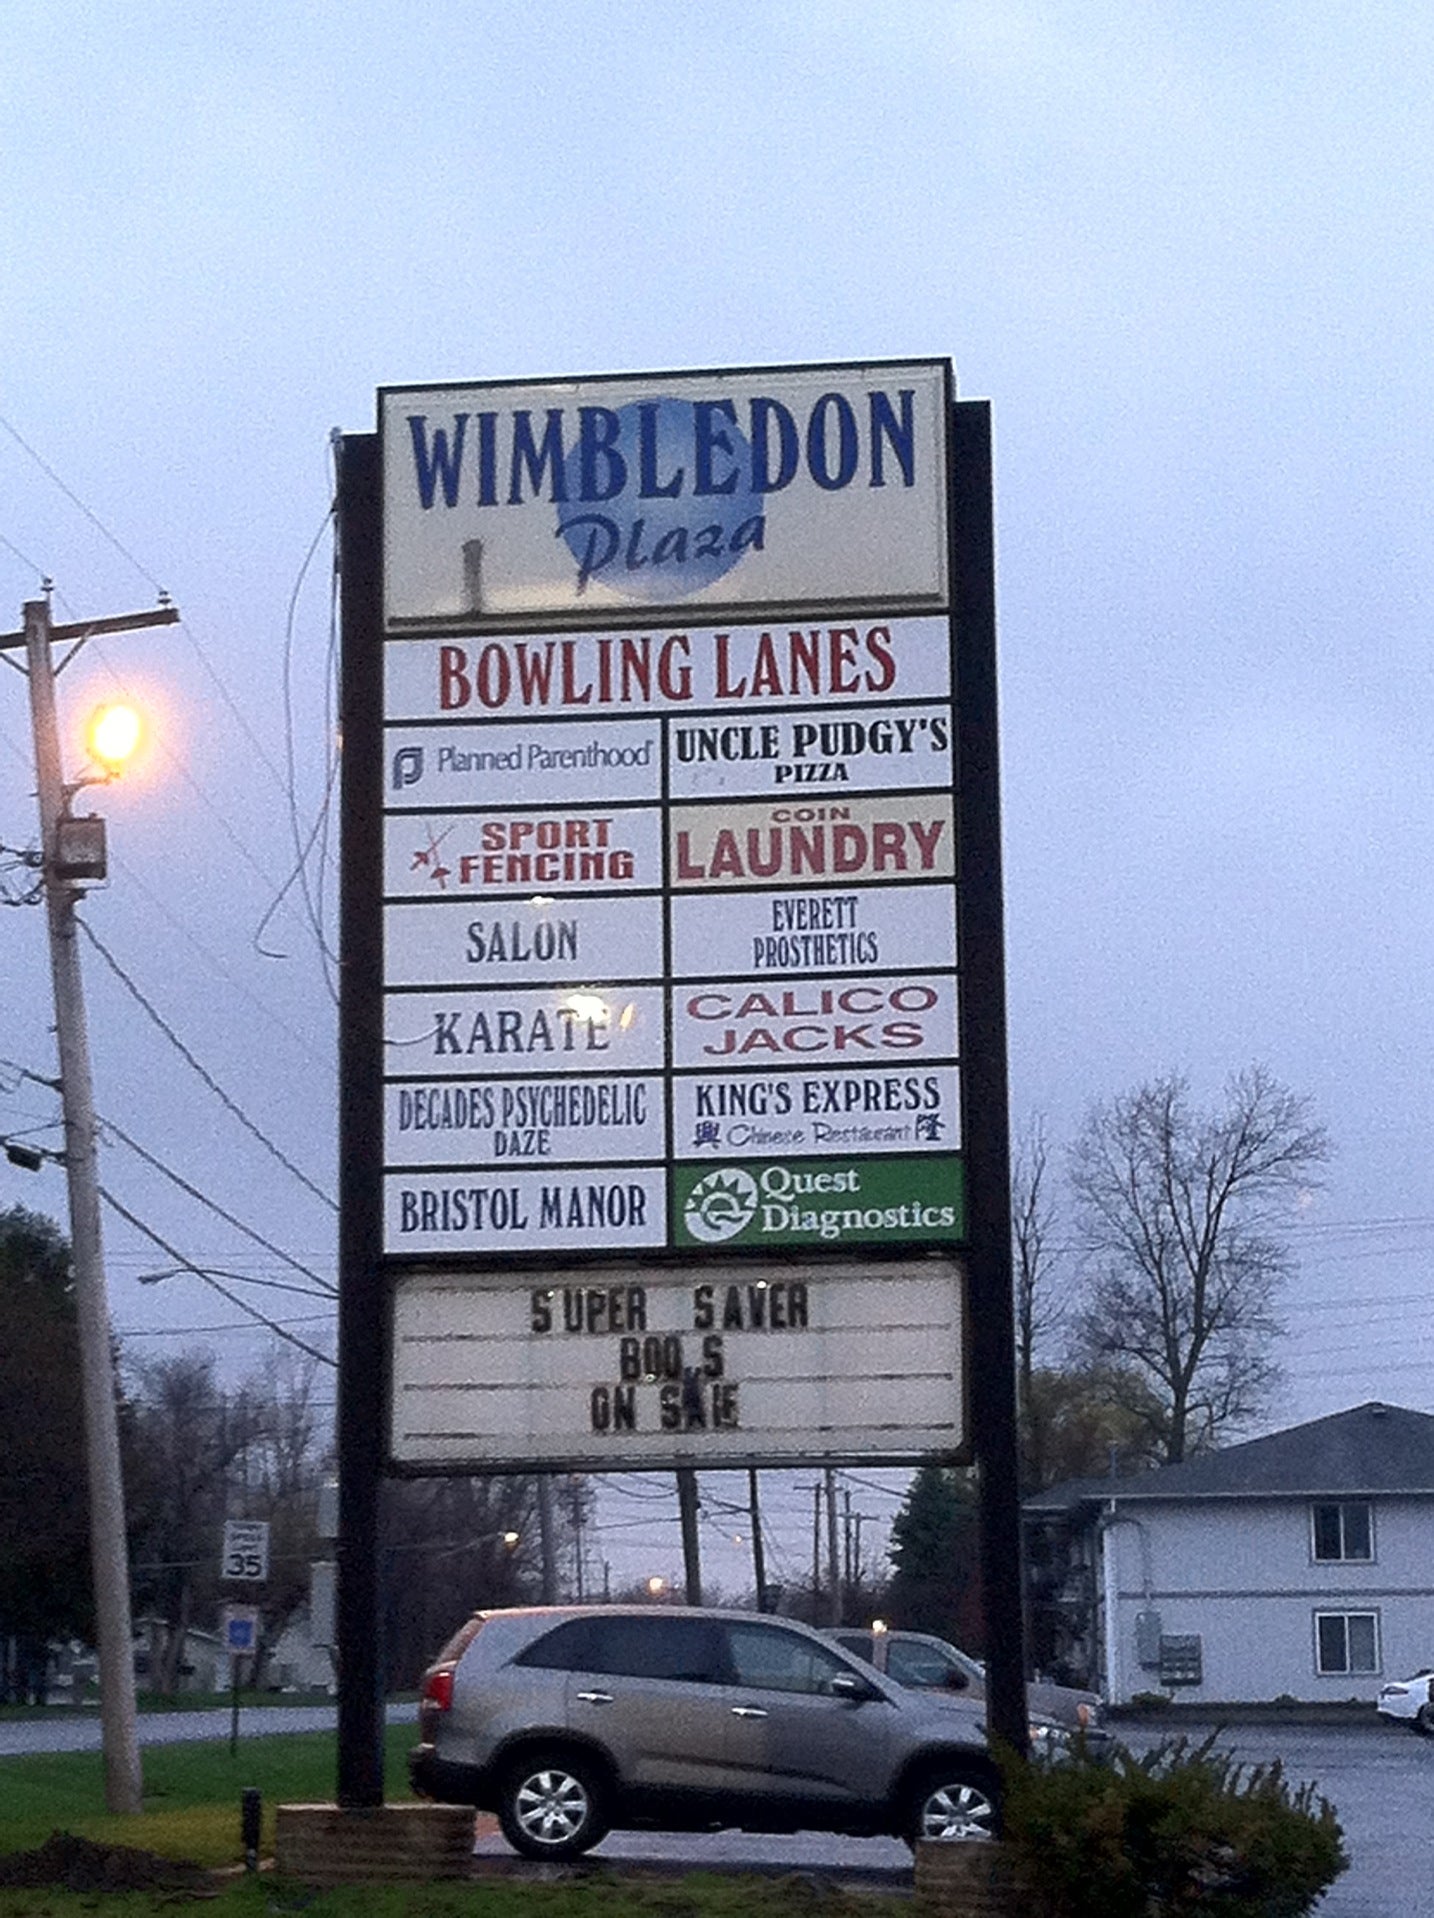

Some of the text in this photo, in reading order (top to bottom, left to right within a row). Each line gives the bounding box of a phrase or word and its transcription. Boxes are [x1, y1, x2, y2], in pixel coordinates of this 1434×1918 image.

[406, 389, 916, 510] WIMBLEDON
[555, 512, 766, 596] Plaza
[438, 625, 896, 712] BOWLING LANES
[438, 739, 651, 772] Planned Parenthood
[676, 716, 948, 764] UNCLE PUDGY'S
[773, 762, 850, 784] PIZZA
[770, 806, 852, 825] COIN
[480, 818, 614, 852] SPORT
[675, 819, 946, 881] LAUNDRY
[458, 848, 635, 886] FENCING
[772, 896, 859, 932] EVERETT
[465, 920, 579, 964] SALON
[753, 931, 880, 969] PROSTHETICS
[685, 985, 939, 1021] CALICO
[433, 1006, 611, 1056] KARATE
[703, 1021, 926, 1055] JACKS
[399, 1083, 648, 1132] DECADES PSYCHEDELIC
[695, 1076, 942, 1118] KING'S EXPRESS
[493, 1129, 552, 1158] DAZE
[726, 1123, 806, 1148] Chinese
[759, 1166, 861, 1202] Quest
[400, 1184, 648, 1234] BRISTOL MANOR
[759, 1203, 957, 1241] Diagnostics
[531, 1283, 809, 1333] SUPER SAVER
[591, 1385, 636, 1430] ON
[227, 1553, 262, 1577] 35
